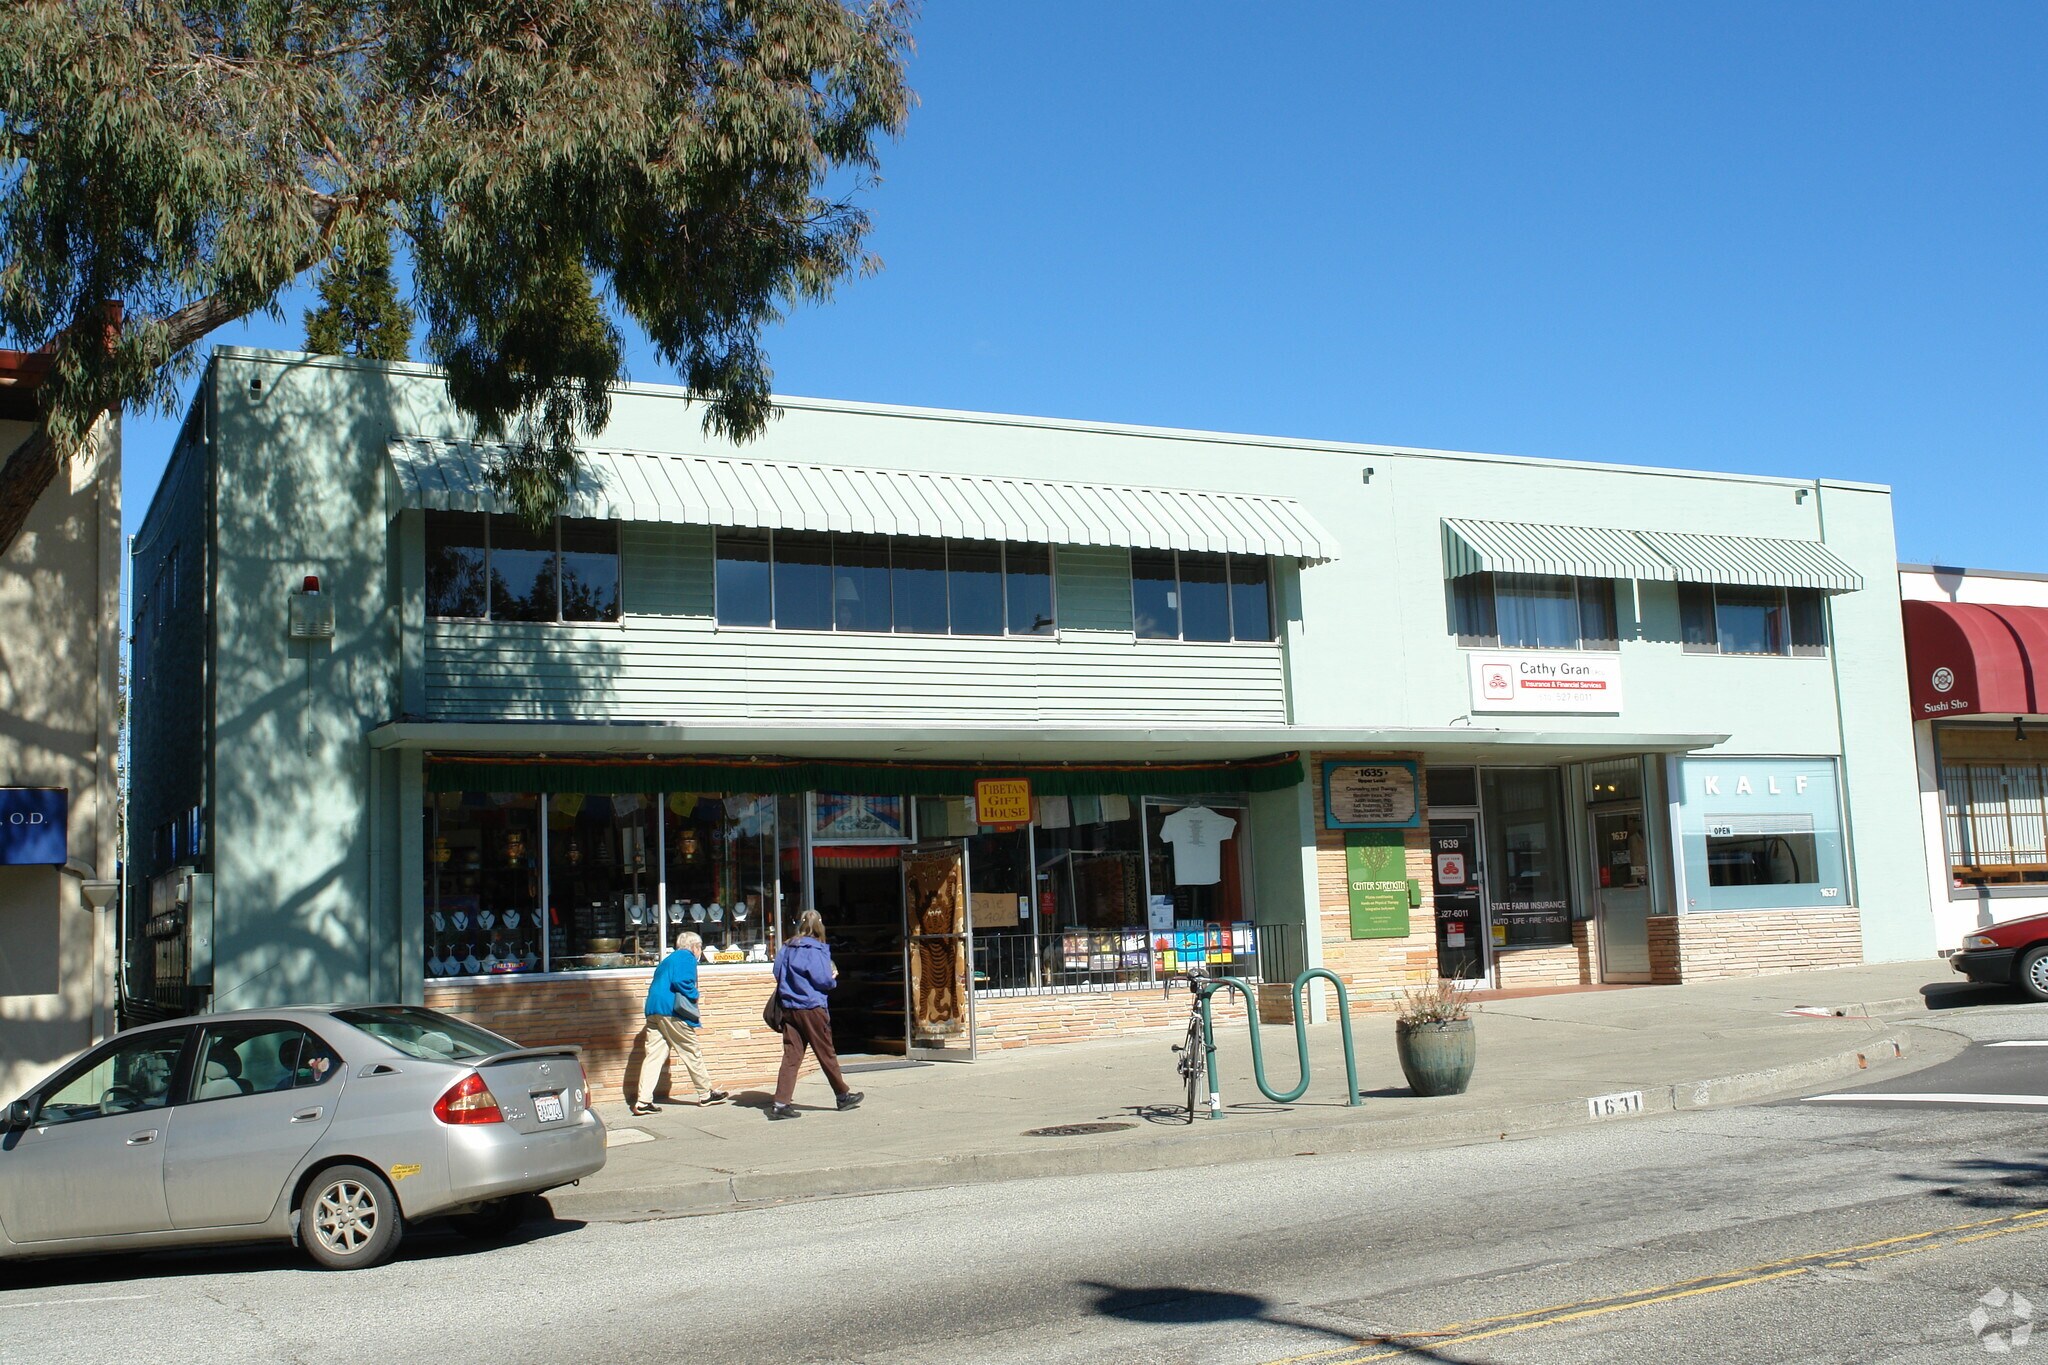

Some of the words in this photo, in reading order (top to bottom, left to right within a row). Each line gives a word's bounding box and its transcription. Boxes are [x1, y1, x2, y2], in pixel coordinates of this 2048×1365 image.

[1520, 662, 1556, 676] Cathy
[1561, 663, 1590, 675] Gran
[1557, 693, 1571, 701] 527
[1574, 693, 1592, 701] 6011
[1924, 701, 1949, 713] Sushi
[1951, 699, 1968, 709] Sho
[1360, 768, 1383, 777] 1635
[981, 784, 1026, 795] TIBETAN
[1704, 775, 1808, 795] KALF
[988, 796, 1021, 805] GIFT
[984, 807, 1026, 818] HOUSE
[10, 812, 48, 825] O.D.
[1611, 831, 1628, 841] 1637
[1714, 827, 1731, 835] OPEN
[1438, 839, 1459, 849] 1639
[1353, 881, 1375, 891] CENTER
[1375, 881, 1406, 891] STRENGTH
[1820, 887, 1838, 897] 1637
[1491, 902, 1511, 911] STATE
[1511, 902, 1530, 910] FARM
[1530, 900, 1566, 910] INSURANCE
[1176, 919, 1190, 927] ALVIN
[1190, 919, 1204, 927] AILEY
[1493, 917, 1509, 925] AUTO
[1512, 917, 1526, 925] LIFE
[714, 953, 743, 961] KINDNESS
[1594, 1094, 1639, 1116] 1631
